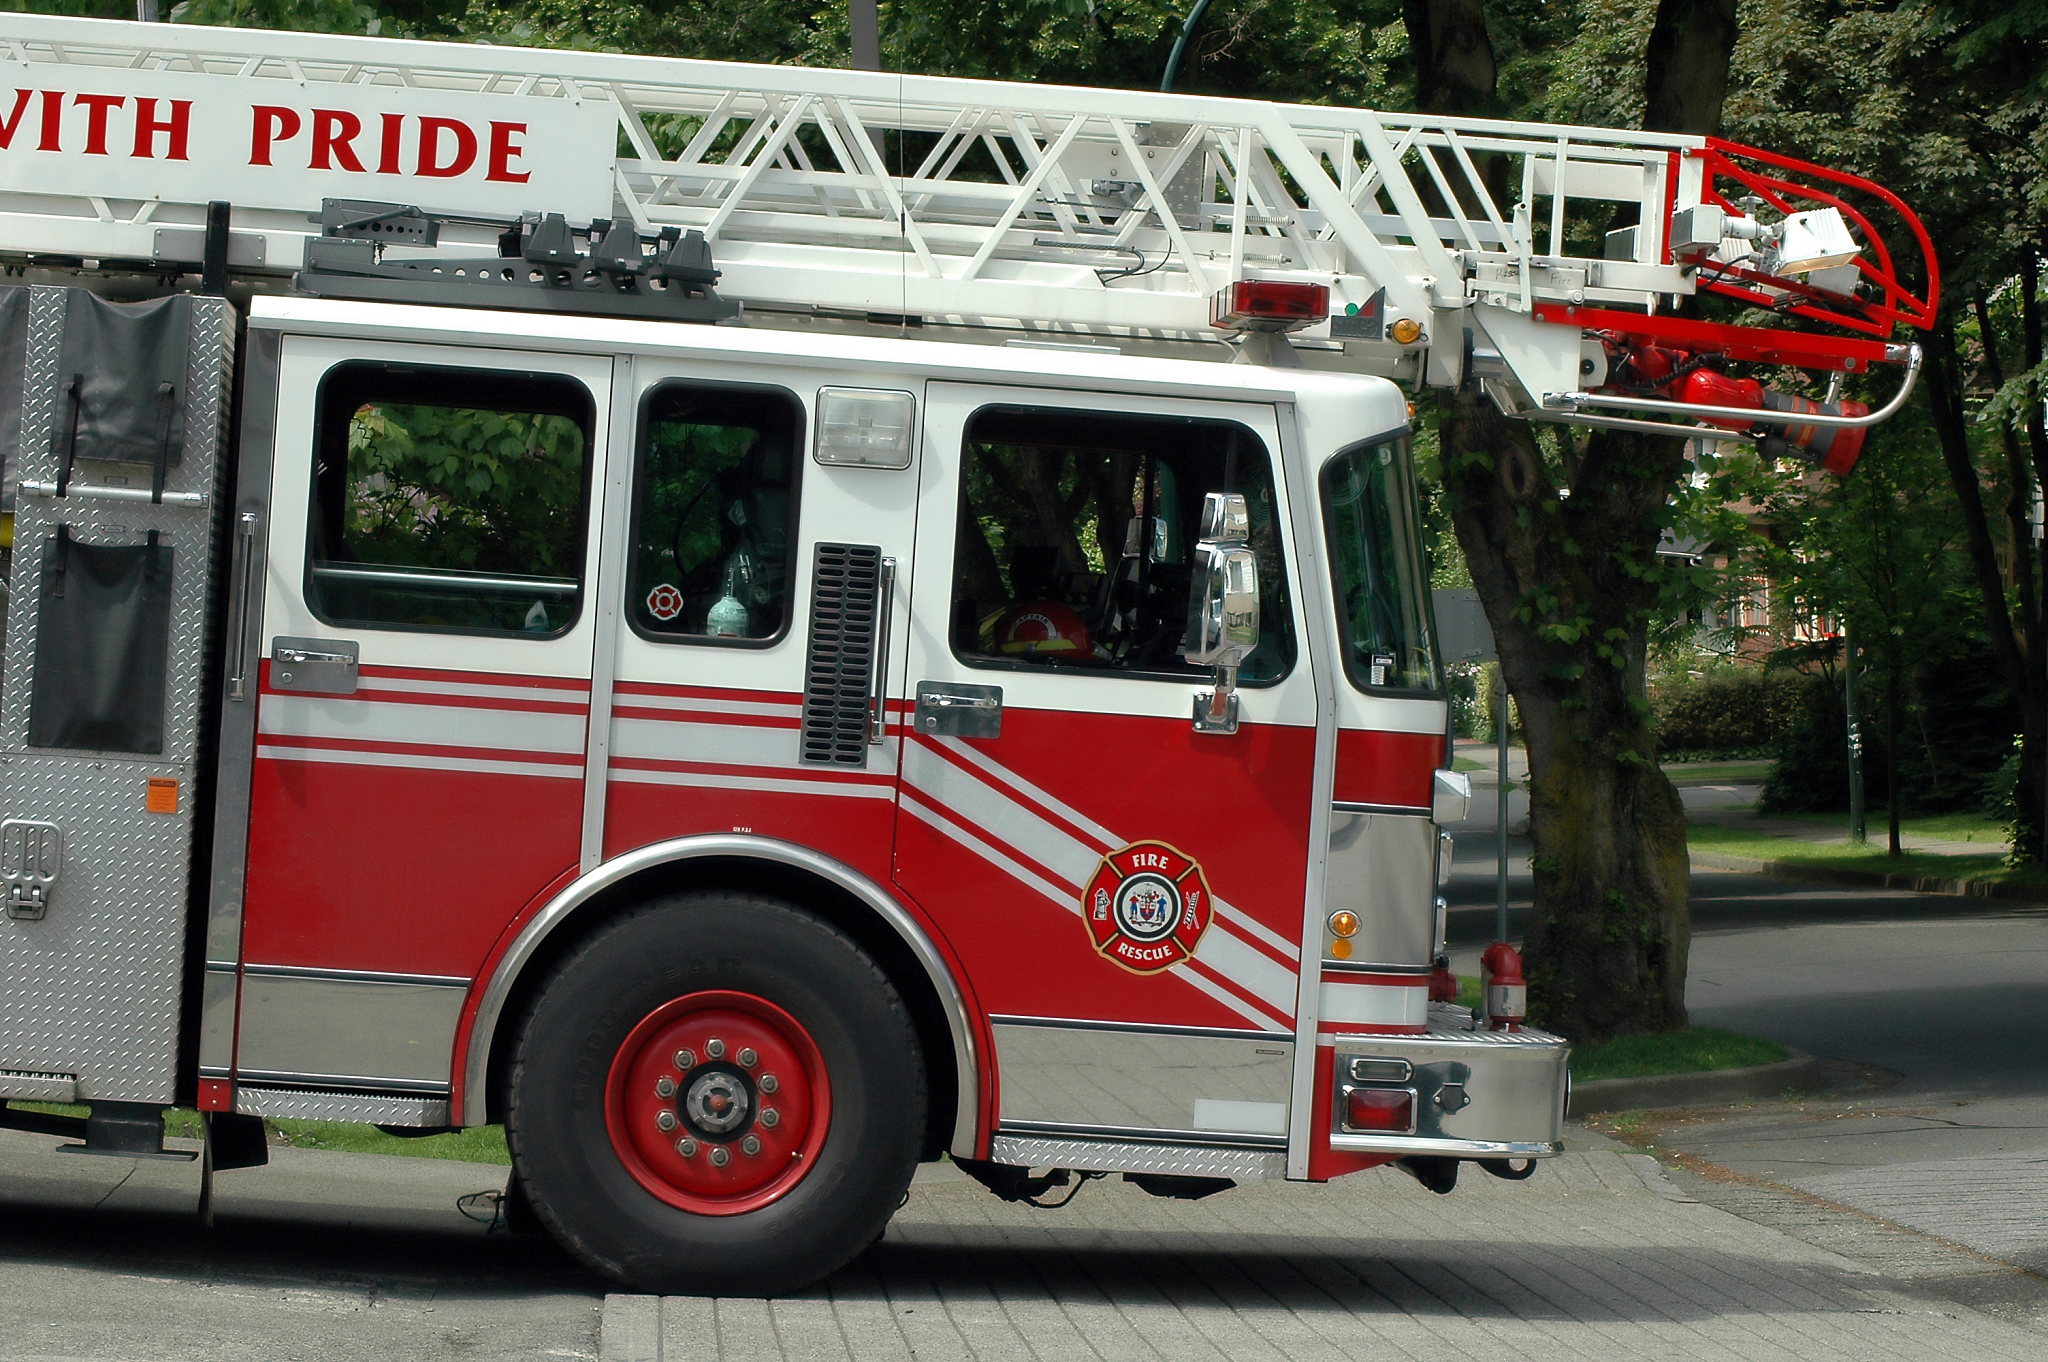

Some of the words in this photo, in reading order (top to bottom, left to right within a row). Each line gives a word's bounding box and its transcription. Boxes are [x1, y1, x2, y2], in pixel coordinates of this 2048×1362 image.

[248, 104, 532, 184] PRIDE
[1550, 271, 1571, 285] Fire
[1014, 614, 1048, 626] CAPTAIN
[1132, 853, 1169, 870] FIRE
[1117, 942, 1173, 961] RESCUE
[572, 956, 741, 1110] GOODYEAR
